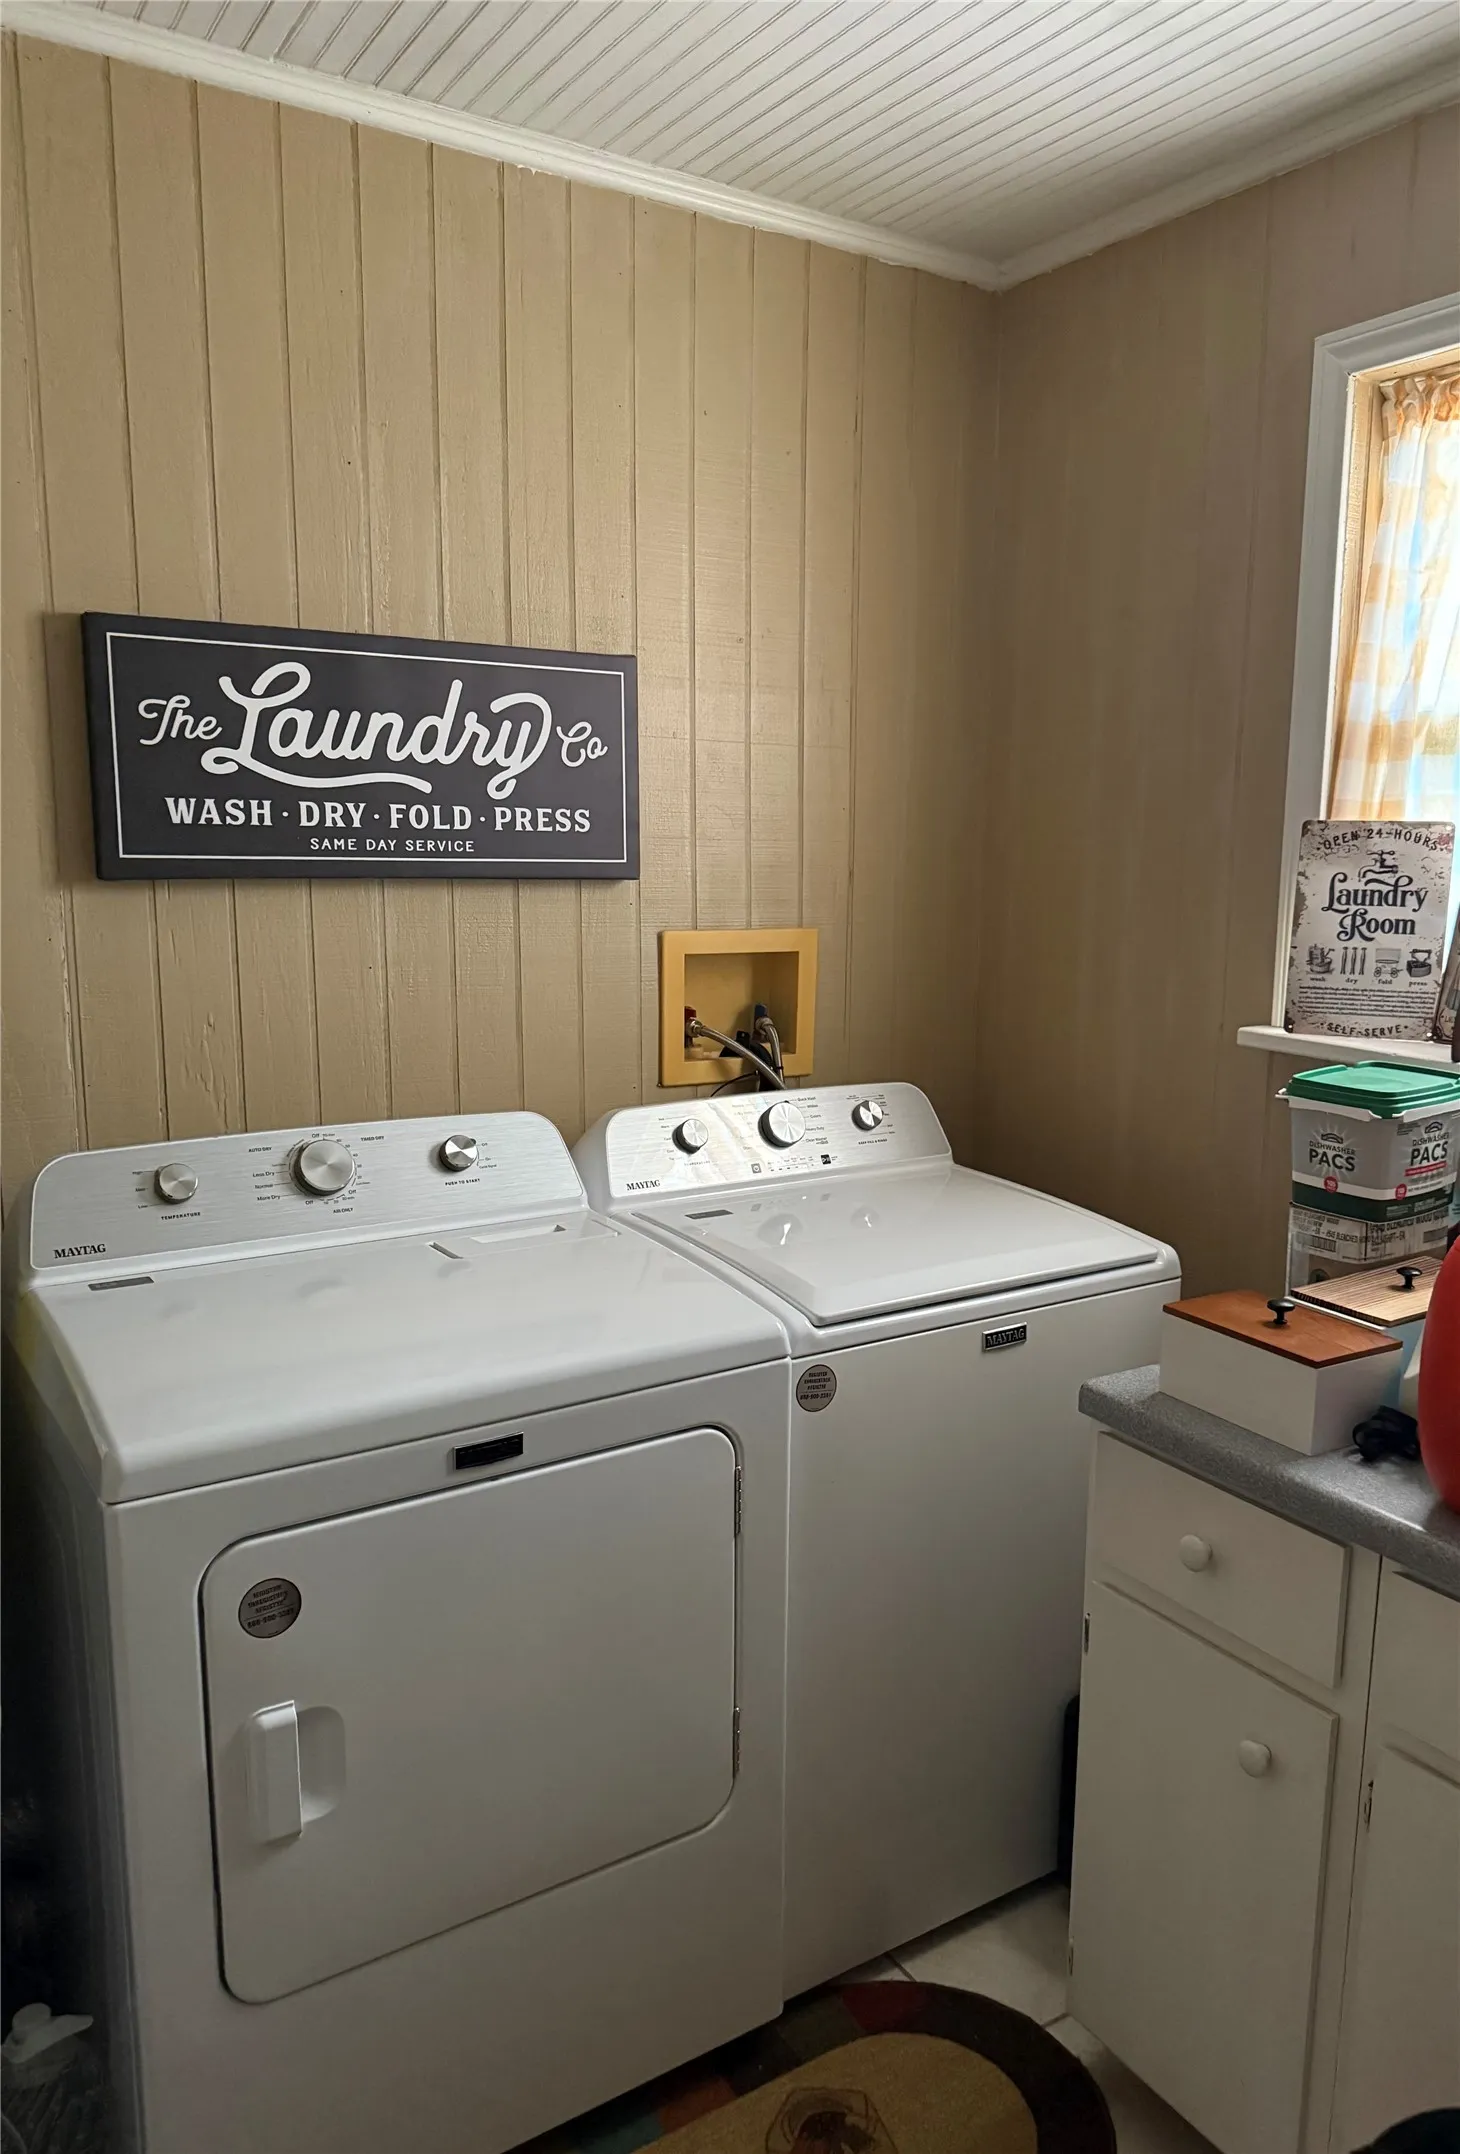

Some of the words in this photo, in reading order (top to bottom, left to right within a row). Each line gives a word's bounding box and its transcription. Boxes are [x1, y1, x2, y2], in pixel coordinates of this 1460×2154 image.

[138, 695, 222, 745] The
[200, 661, 552, 801] Laundry
[556, 721, 608, 768] Co
[164, 797, 273, 827] WASH
[299, 801, 366, 829] DRY
[389, 804, 473, 831] FOLD
[494, 807, 592, 833] PRESS
[310, 837, 358, 852] SAME
[365, 839, 398, 853] DAY
[405, 840, 475, 854] SERVICE
[1323, 830, 1359, 850] OPEN
[1321, 872, 1429, 913] Laundry
[1337, 908, 1416, 942] Room
[1309, 1140, 1356, 1155] DISHWASHER
[1410, 1141, 1449, 1166] PACS
[1309, 1147, 1356, 1172] PACS
[626, 1179, 661, 1192] MAYTAG
[161, 1212, 200, 1220] TEMPERATURE
[54, 1243, 106, 1259] MAYTAG
